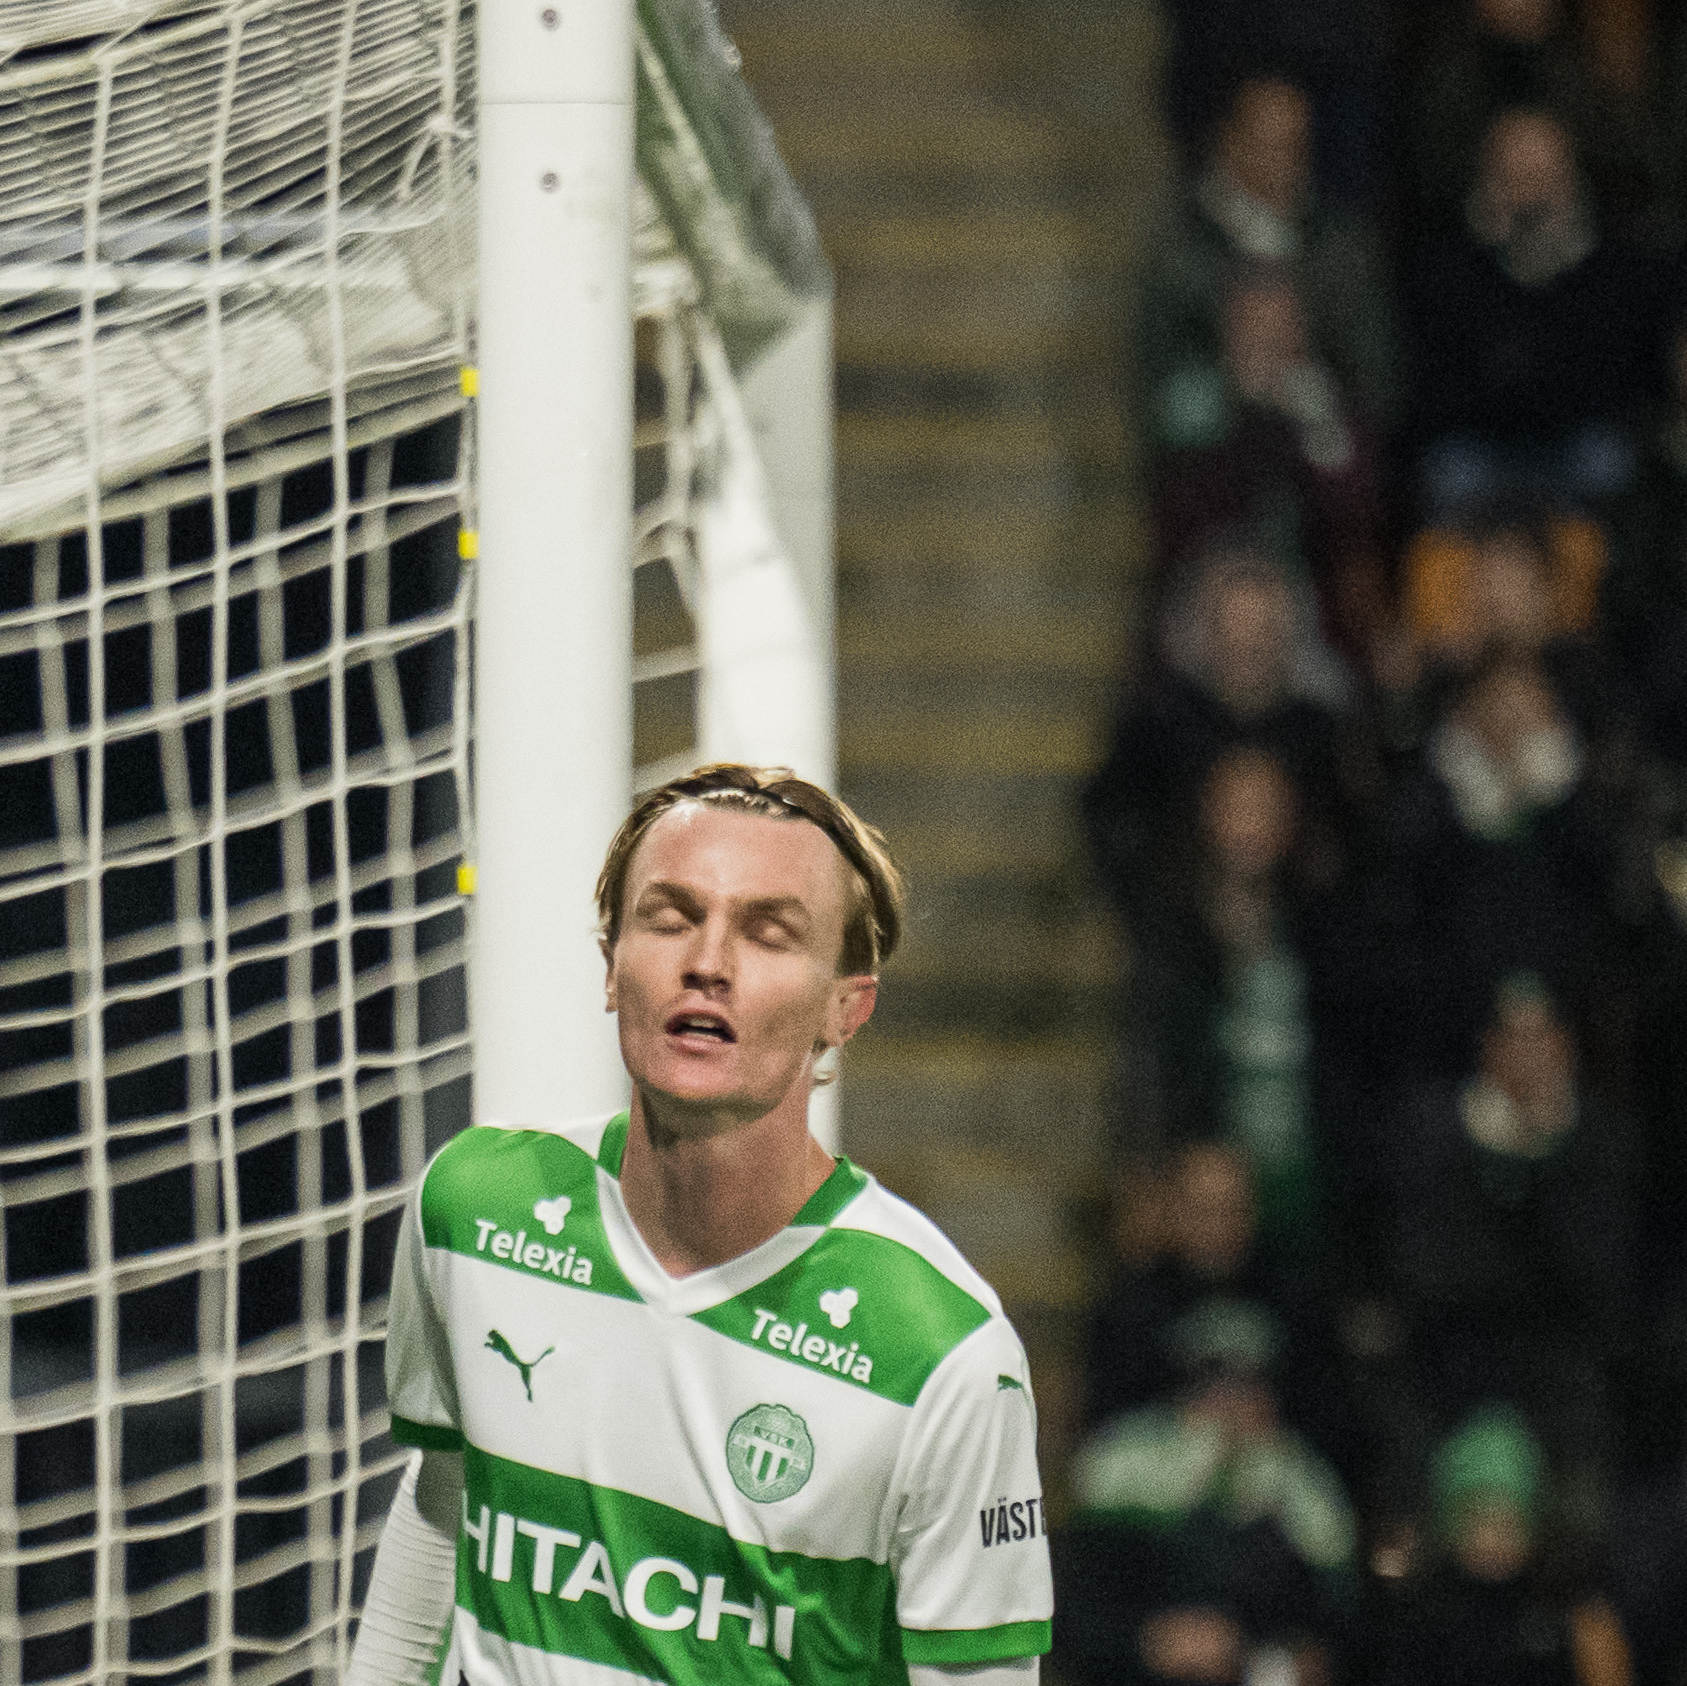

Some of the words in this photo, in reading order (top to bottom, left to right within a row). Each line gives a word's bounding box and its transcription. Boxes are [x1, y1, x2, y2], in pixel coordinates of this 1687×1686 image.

[474, 1217, 595, 1287] Telexia
[751, 1309, 874, 1385] Telexia
[463, 1501, 797, 1661] HITACHI
